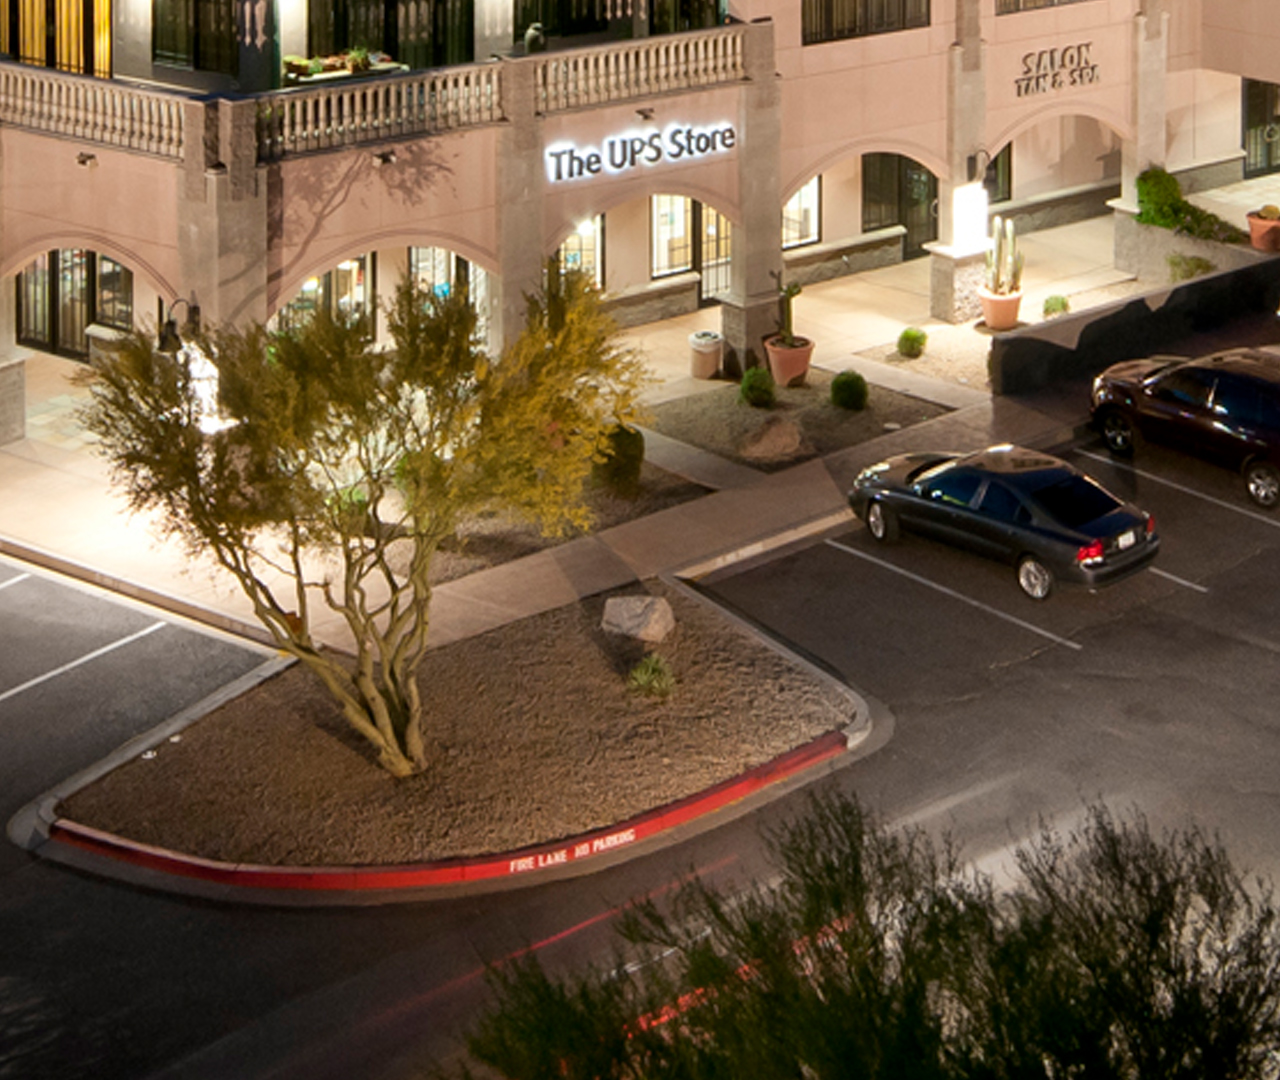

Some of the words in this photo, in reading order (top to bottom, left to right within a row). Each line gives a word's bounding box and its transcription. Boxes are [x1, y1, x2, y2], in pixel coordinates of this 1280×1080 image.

[1022, 41, 1093, 75] SALON
[1014, 73, 1049, 97] TAN
[1051, 71, 1065, 89] &
[1069, 64, 1100, 86] SPA
[549, 149, 601, 180] The
[608, 133, 662, 169] UPS
[668, 126, 736, 159] Store
[510, 857, 535, 873] FIRE
[538, 849, 568, 867] LANE
[574, 843, 590, 858] NO
[593, 828, 636, 852] PARKING
